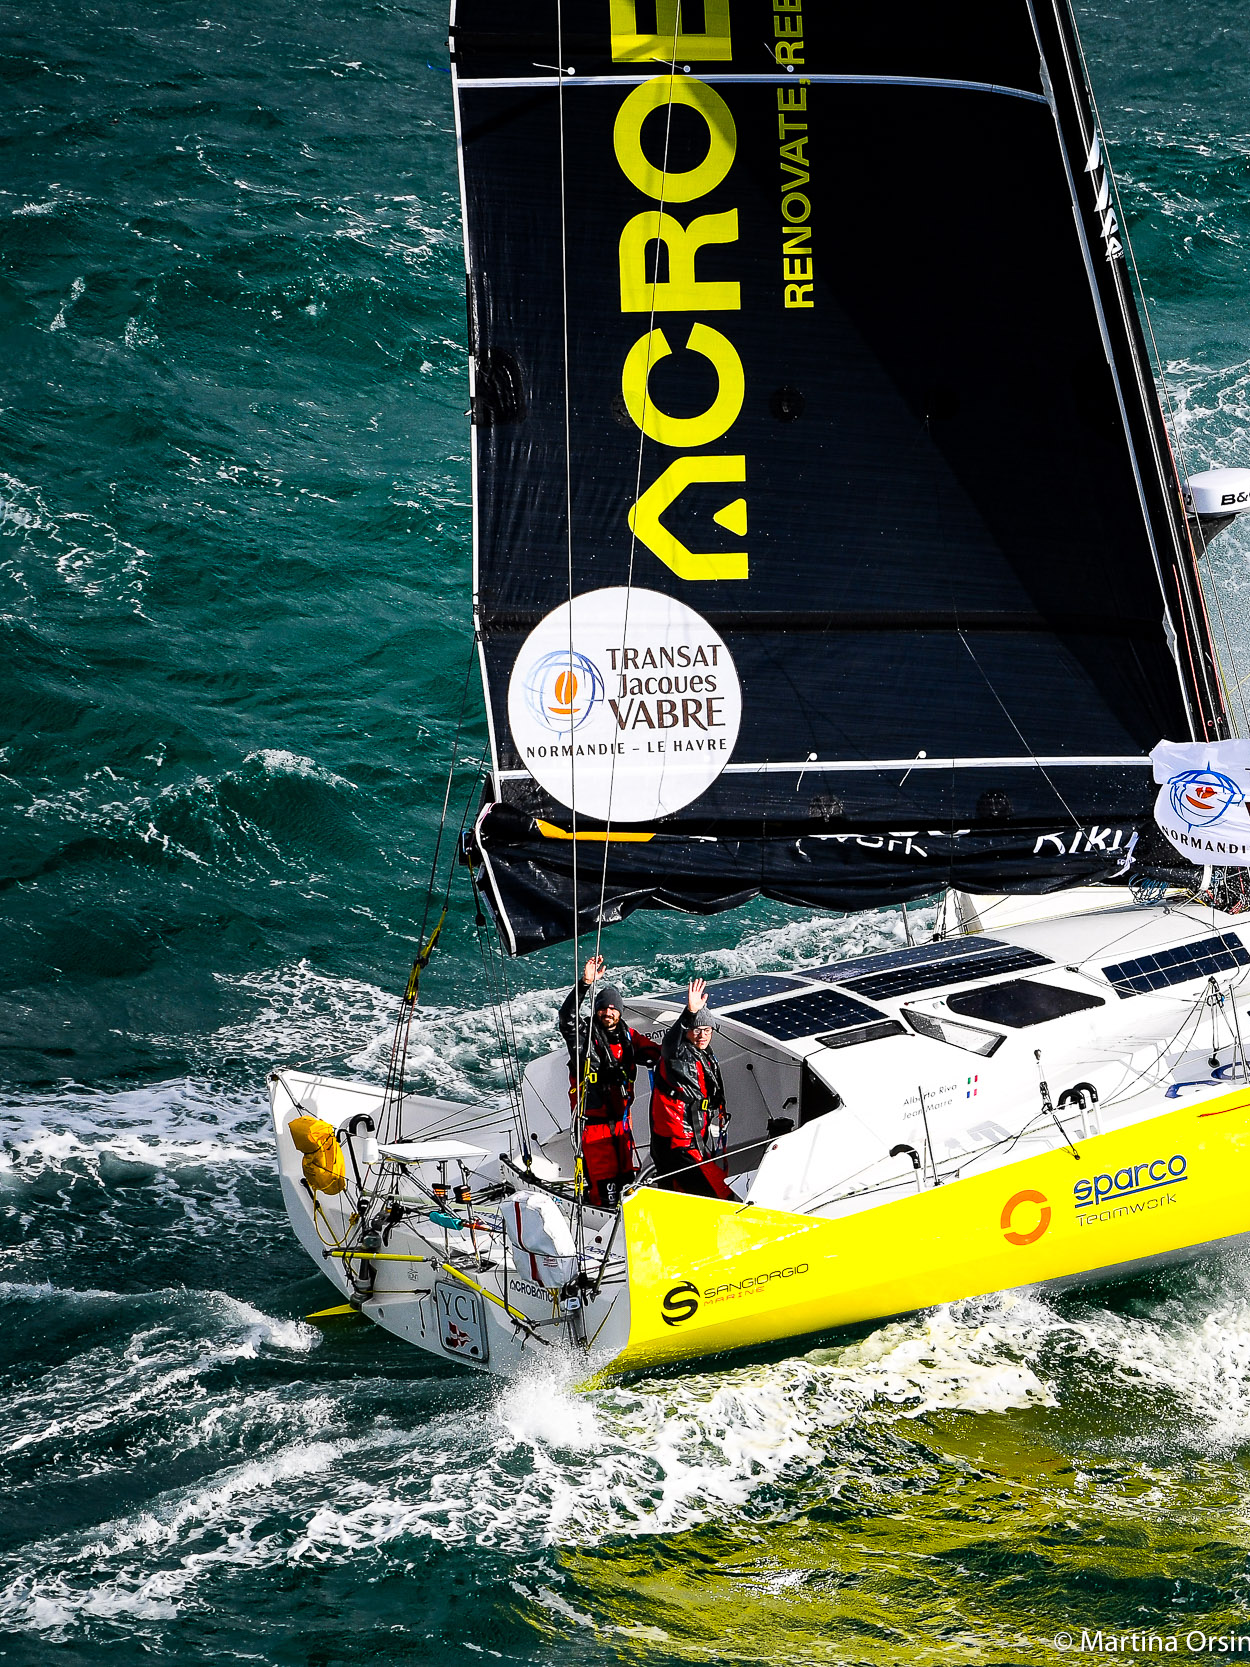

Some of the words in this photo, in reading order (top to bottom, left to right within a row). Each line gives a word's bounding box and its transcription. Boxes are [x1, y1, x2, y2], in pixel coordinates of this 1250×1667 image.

[777, 78, 814, 309] RENOVATE,
[606, 645, 722, 670] TRANSAT
[617, 674, 717, 698] Jacques
[608, 697, 726, 731] VABRE
[527, 742, 625, 758] NORMANDIE
[648, 741, 665, 753] LE
[674, 739, 727, 751] HAVRE
[1073, 1154, 1187, 1207] sparco
[1076, 1193, 1177, 1227] Teamwork
[510, 1279, 554, 1303] ACROBATIC
[703, 1286, 765, 1307] MARINE
[704, 1263, 809, 1298] SANGIORGIO
[439, 1290, 477, 1325] YCI
